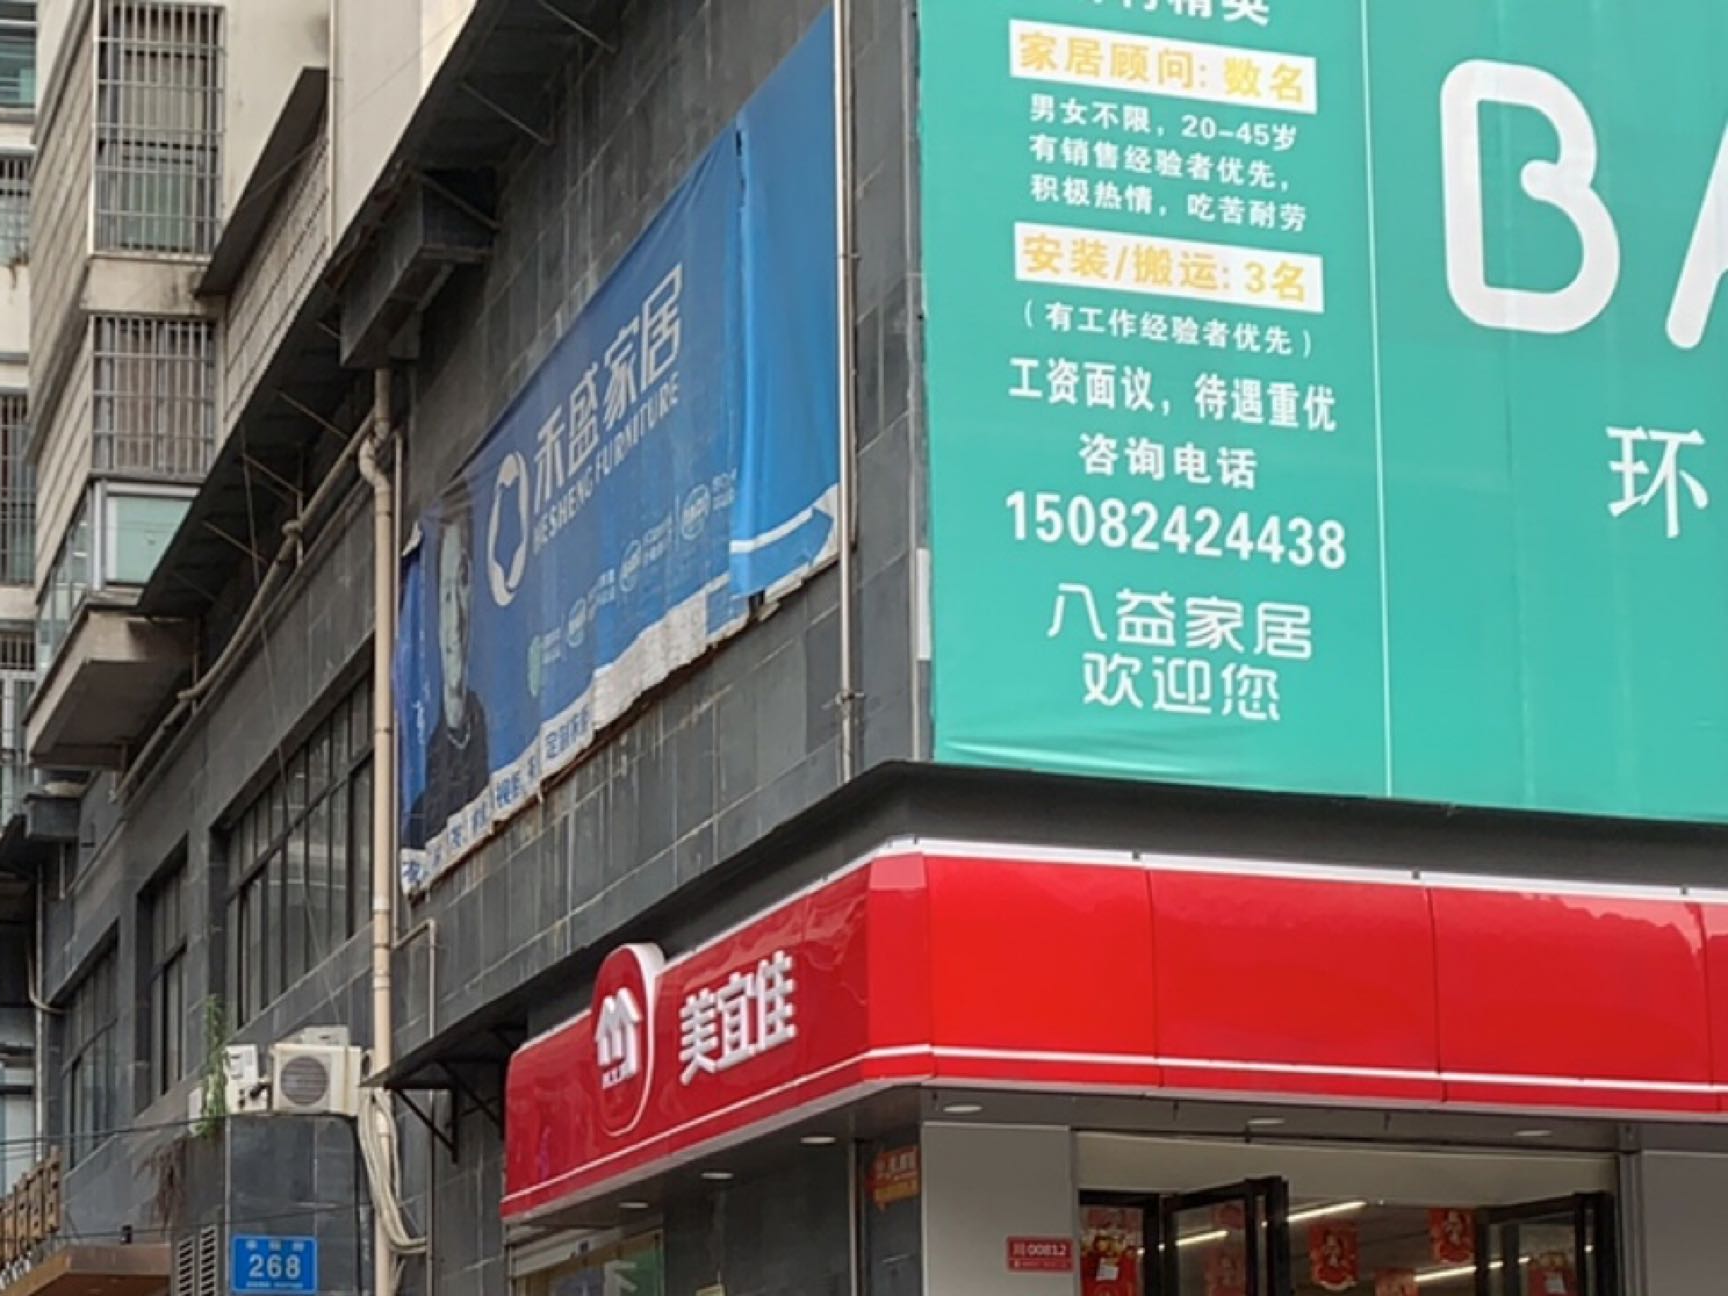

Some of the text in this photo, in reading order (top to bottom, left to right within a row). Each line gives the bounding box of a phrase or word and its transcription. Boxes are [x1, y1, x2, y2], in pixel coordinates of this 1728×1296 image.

[1078, 434, 1259, 490] 咨询电话
[1606, 426, 1708, 539] 环
[1005, 491, 1348, 570] 15082424438
[1047, 582, 1314, 660] 八益家居
[1081, 652, 1282, 722] 欢迎您
[679, 950, 798, 1087] 美宜佳
[248, 1253, 302, 1280] 268
